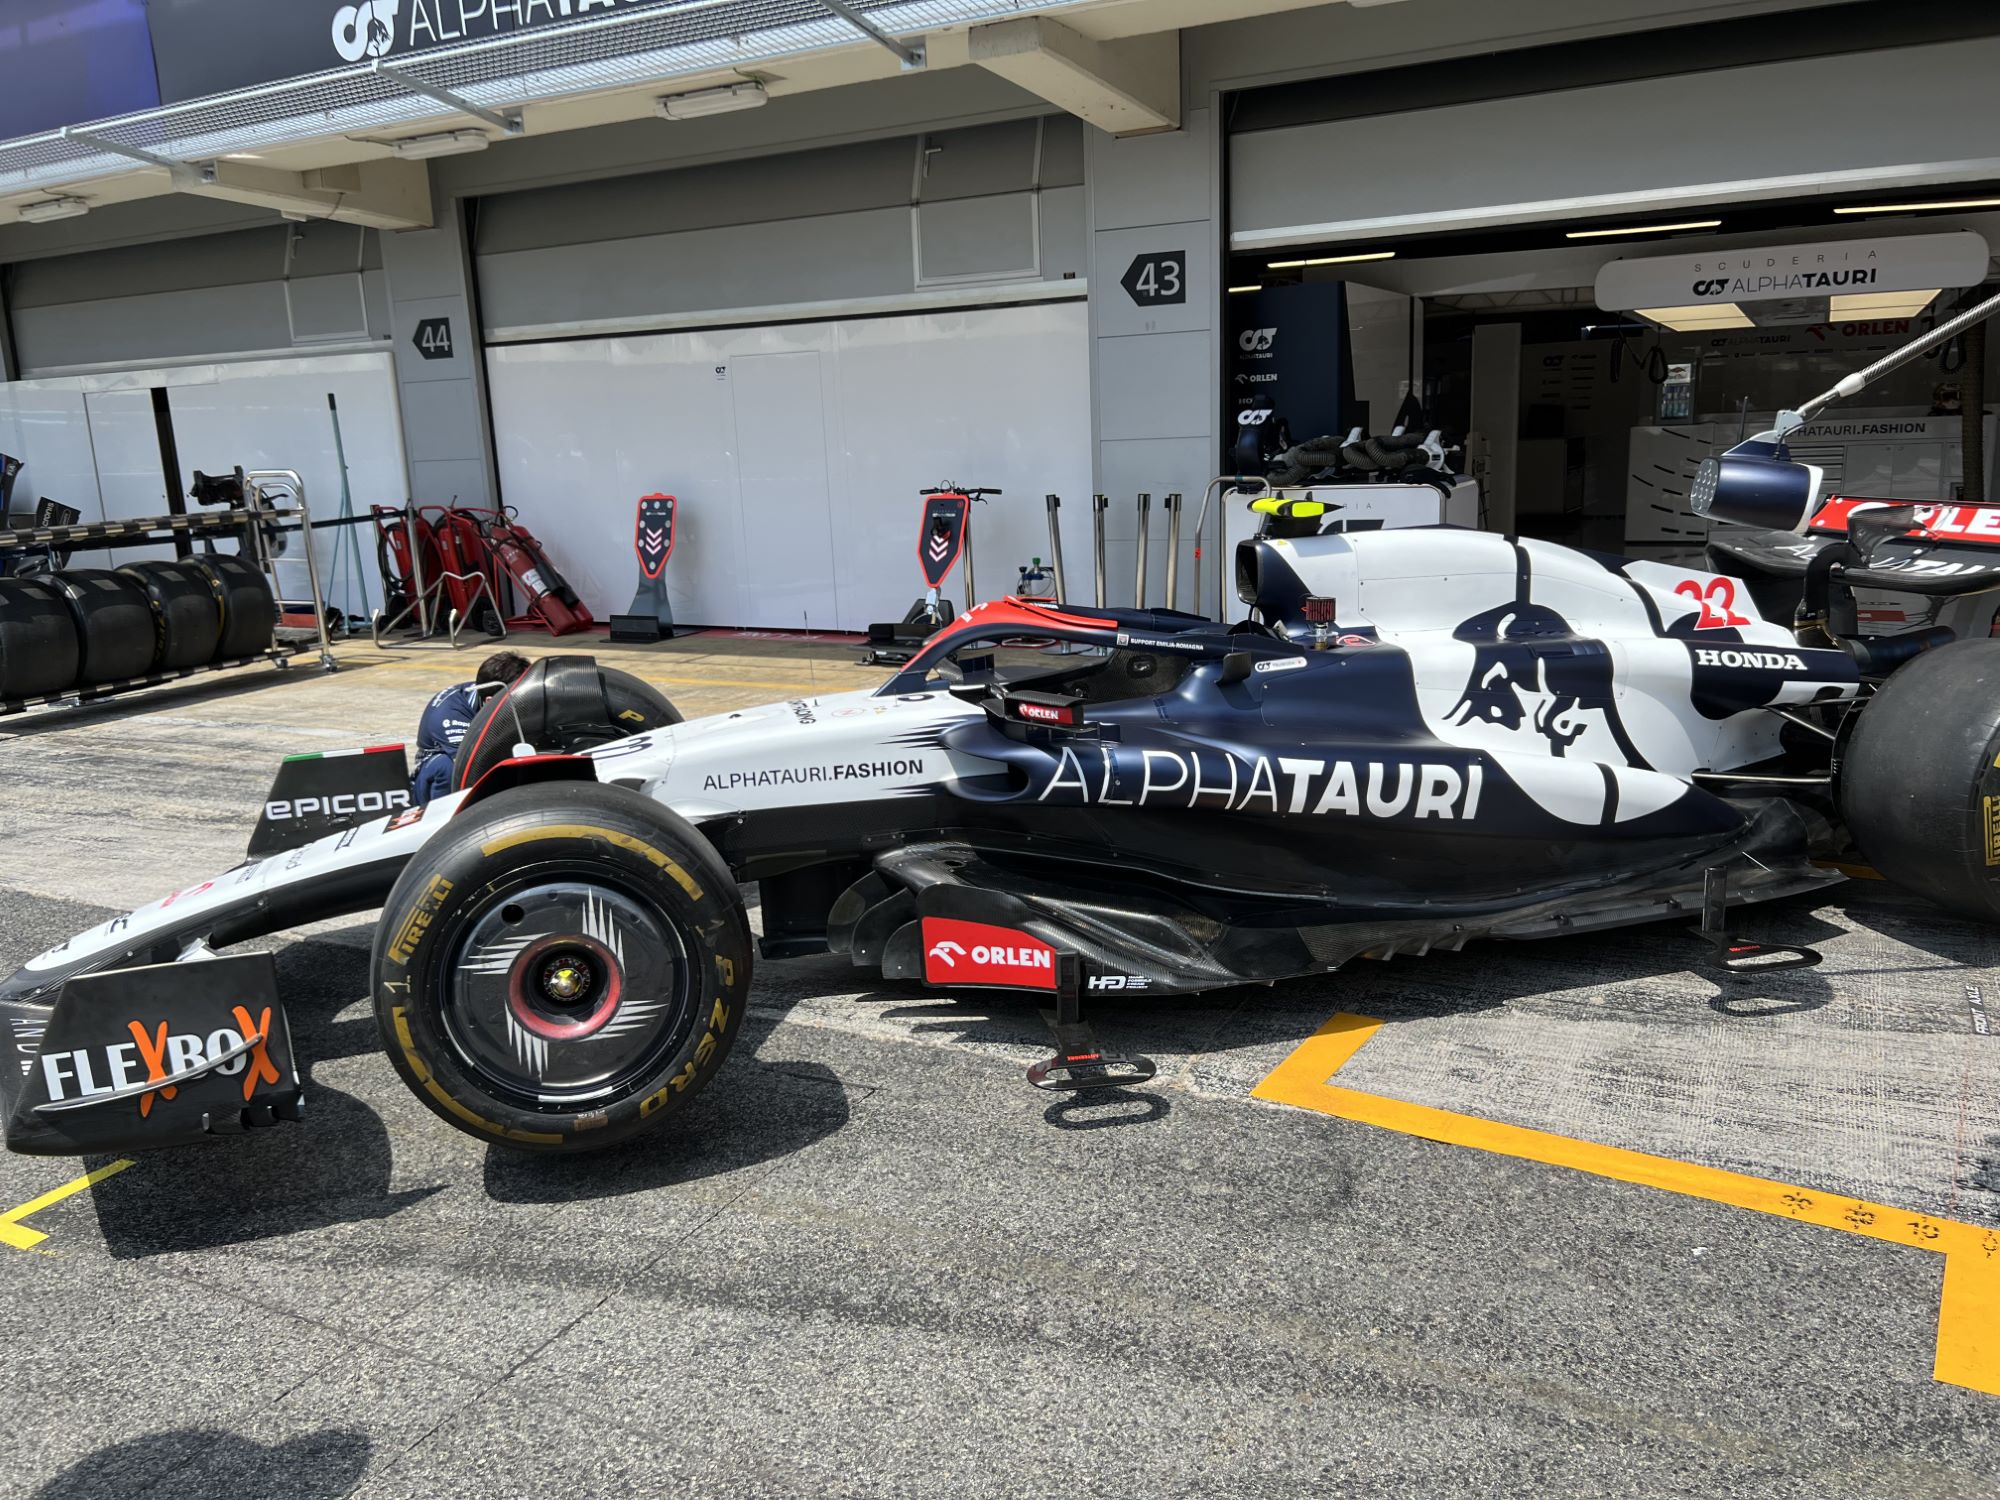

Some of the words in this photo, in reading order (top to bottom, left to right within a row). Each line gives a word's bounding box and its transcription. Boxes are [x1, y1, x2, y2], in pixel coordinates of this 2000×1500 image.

[1695, 250, 1877, 273] SCUDERIA
[1136, 261, 1180, 296] 43
[1732, 268, 1877, 294] ALPHATAURI
[422, 325, 450, 352] 44
[1842, 320, 1910, 338] ORLEN
[1249, 373, 1278, 382] ORLEN
[41, 502, 54, 528] cronis
[1673, 576, 1752, 631] 22
[1130, 638, 1156, 646] SUPPORT
[1694, 649, 1808, 670] HONDA
[1028, 708, 1060, 720] ORLEN
[703, 759, 924, 791] ALPHATAURI.FASHION
[1038, 746, 1483, 820] ALPHATAURI
[971, 945, 1050, 968] ORLEN
[1965, 985, 1983, 1006] AXLE
[1970, 1007, 1991, 1035] FRONT
[41, 1005, 281, 1119] FLEXBOX
